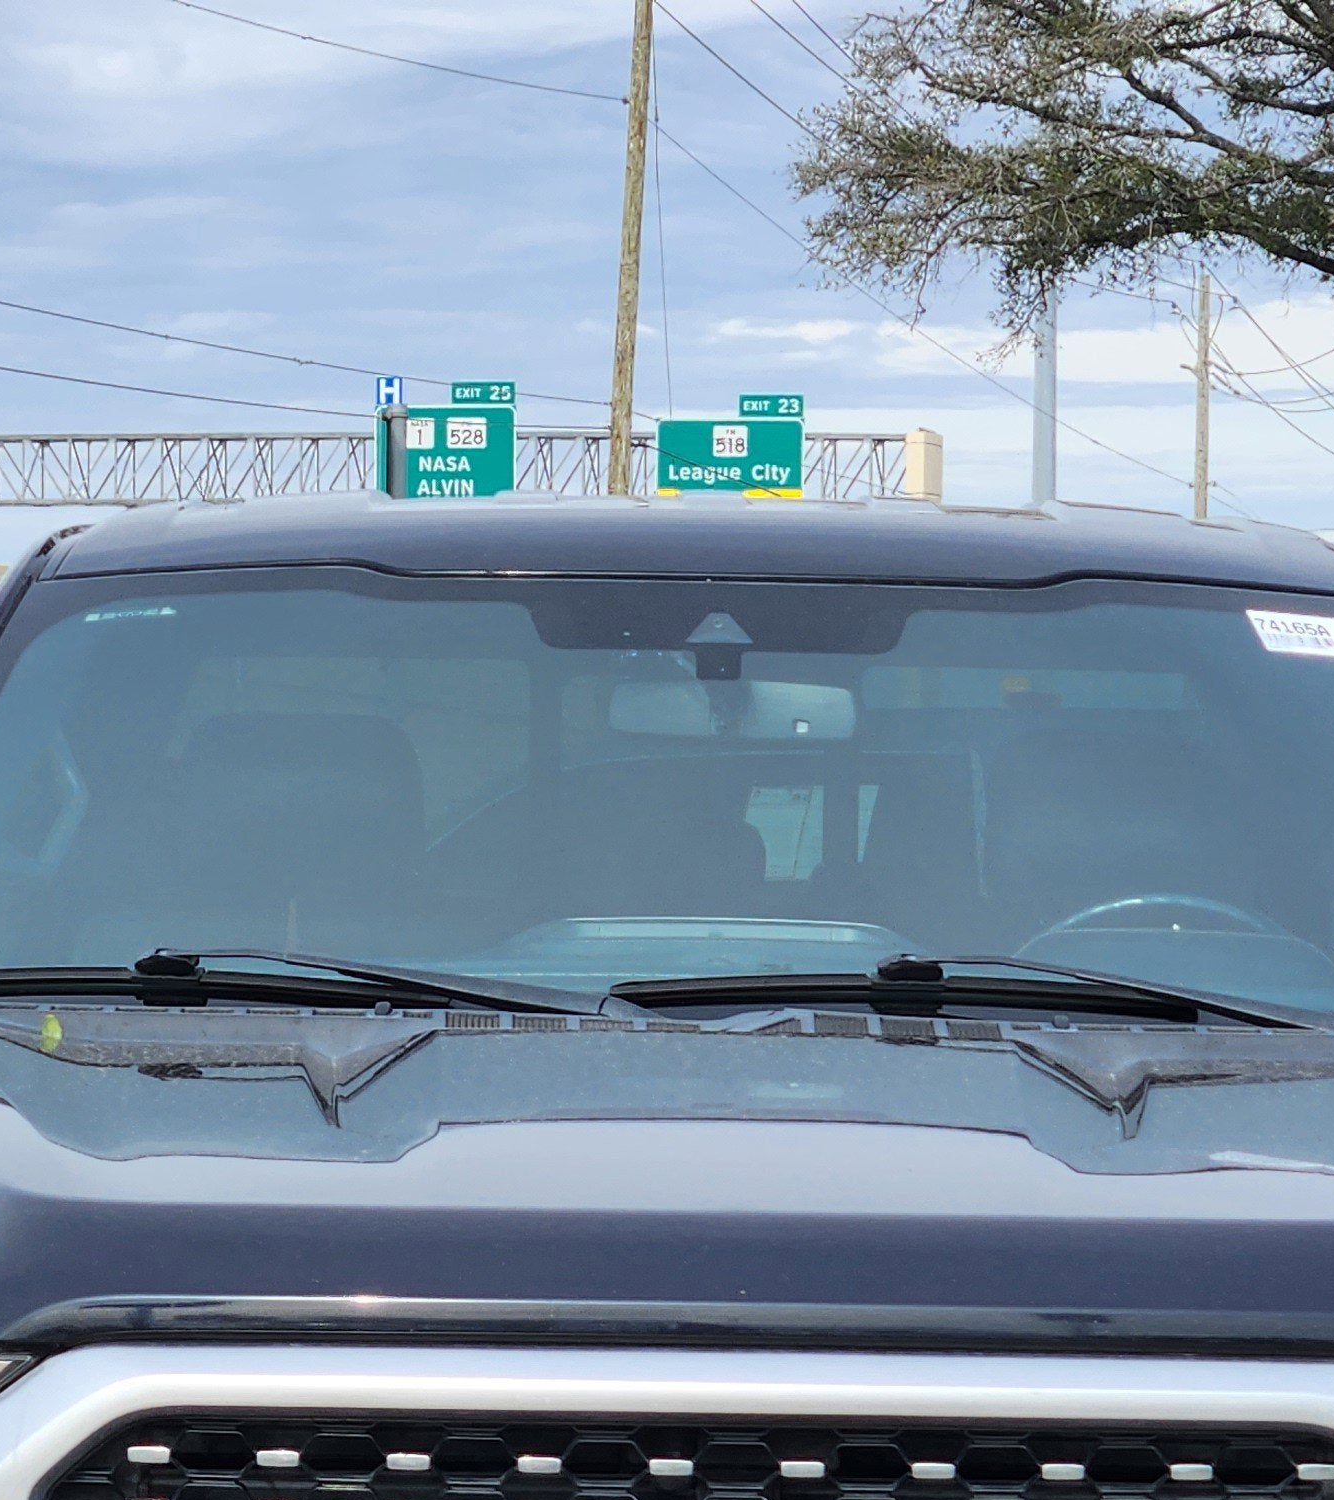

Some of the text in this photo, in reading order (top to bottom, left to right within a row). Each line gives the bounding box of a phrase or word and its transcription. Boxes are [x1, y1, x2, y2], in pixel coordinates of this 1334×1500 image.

[378, 377, 400, 404] H
[455, 385, 511, 401] EXIT 25
[743, 399, 800, 414] EXIT 23
[417, 428, 423, 446] 1
[449, 429, 484, 445] 528
[715, 437, 745, 453] 518
[418, 455, 471, 472] NASA
[668, 463, 791, 485] League City
[416, 478, 474, 498] ALVIN
